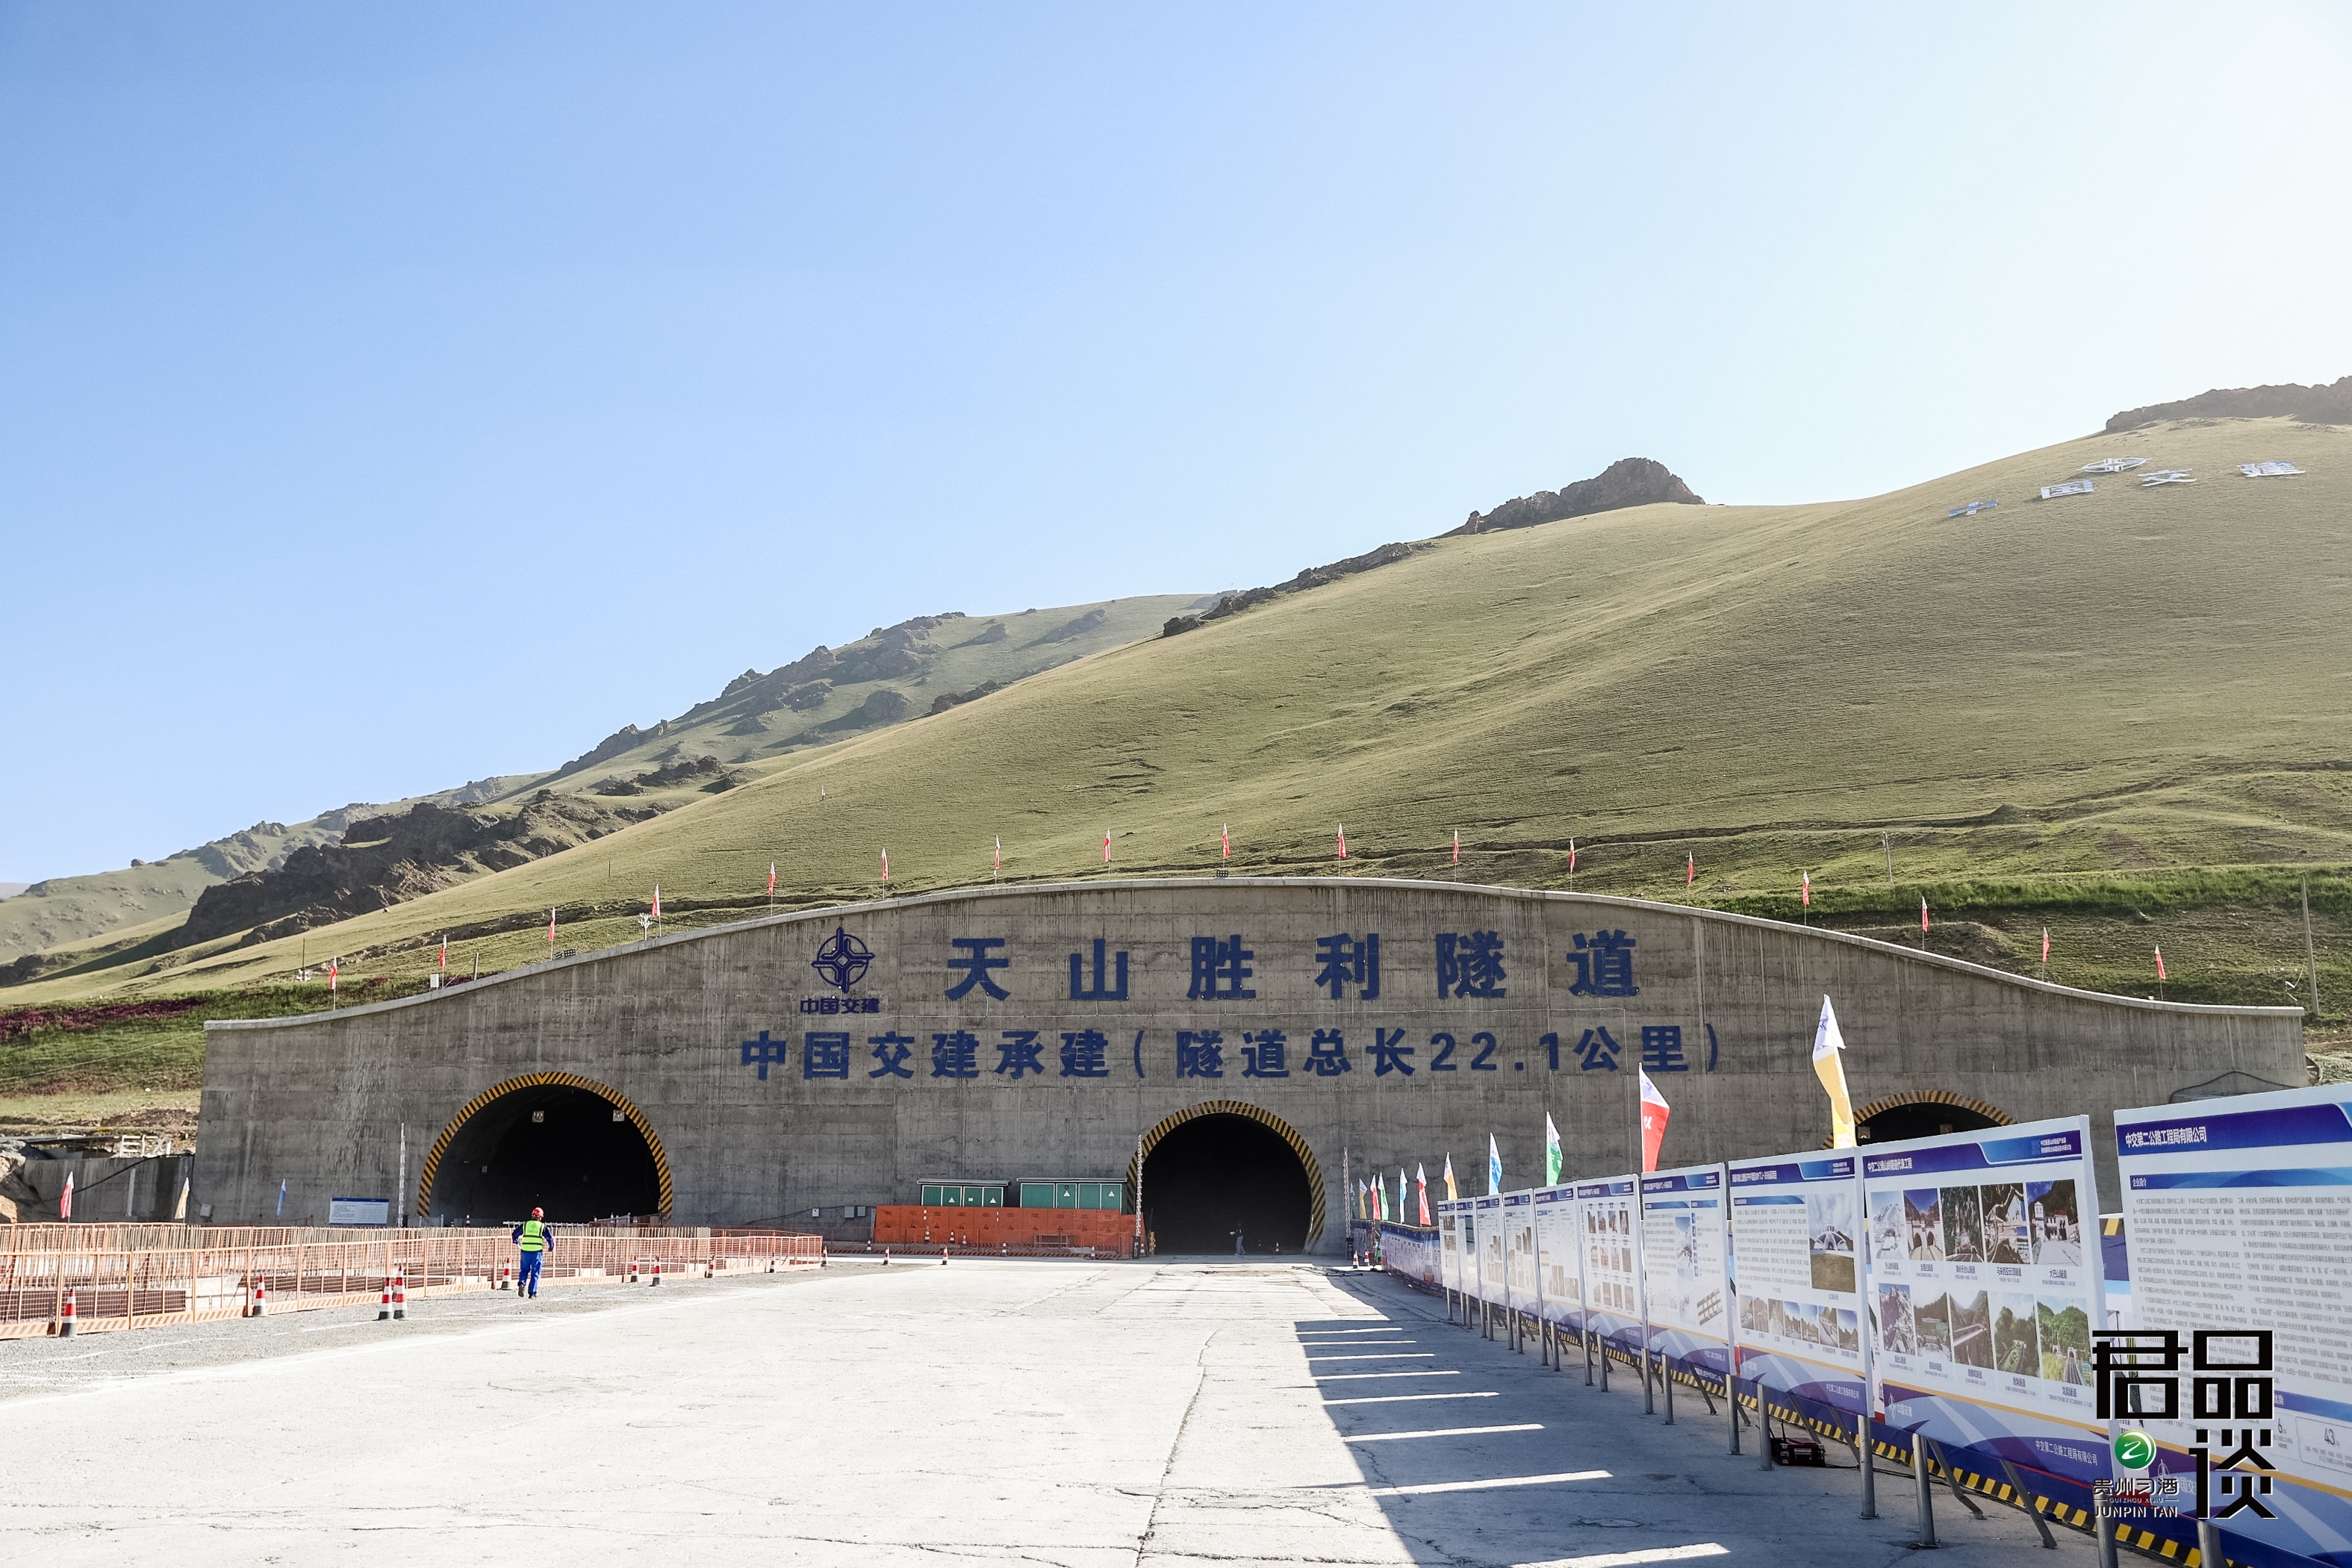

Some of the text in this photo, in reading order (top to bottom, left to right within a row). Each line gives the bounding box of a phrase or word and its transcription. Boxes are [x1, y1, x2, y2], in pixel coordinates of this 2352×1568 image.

[945, 929, 1640, 1001] 天山胜利隧道
[800, 997, 880, 1015] 中国交建
[2125, 1126, 2207, 1148] 中交第二公路工程局有限公司
[2035, 1439, 2098, 1466] 中交第二公路工程局有限公司
